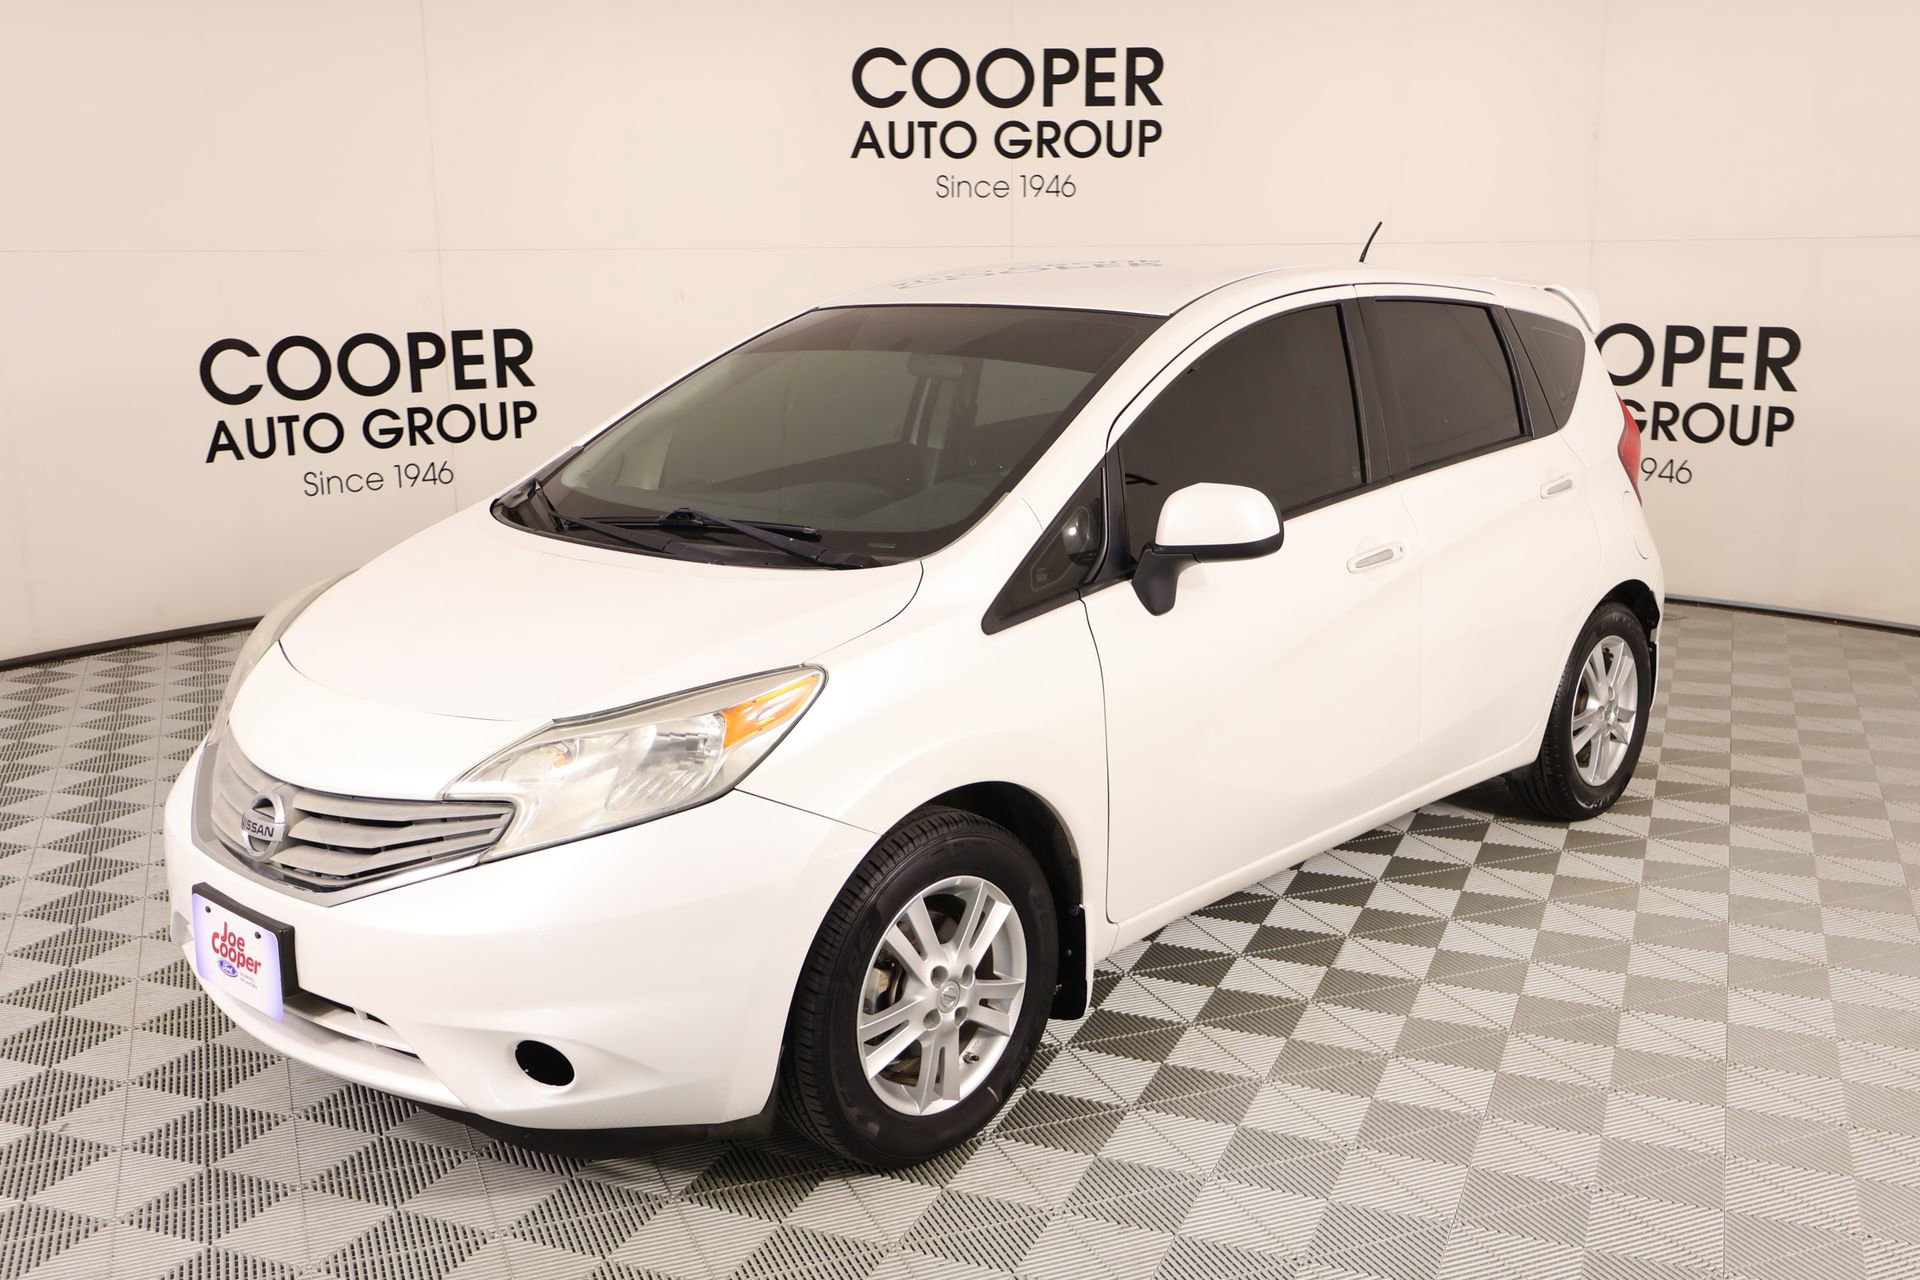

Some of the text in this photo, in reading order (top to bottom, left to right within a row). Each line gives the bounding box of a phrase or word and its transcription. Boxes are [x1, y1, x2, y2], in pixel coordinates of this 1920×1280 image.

[851, 47, 1165, 109] COOPER
[850, 119, 1163, 160] AUTO GROUP
[935, 174, 1077, 199] Since 1946
[199, 328, 537, 406] COOPER
[1594, 322, 1802, 393] OPER
[205, 401, 538, 464] AUTO GROUP
[303, 461, 455, 497] Since 1946
[1640, 457, 1693, 485] 946
[241, 813, 275, 838] NISSAN
[211, 931, 262, 975] Cooper
[220, 921, 245, 952] Joe
